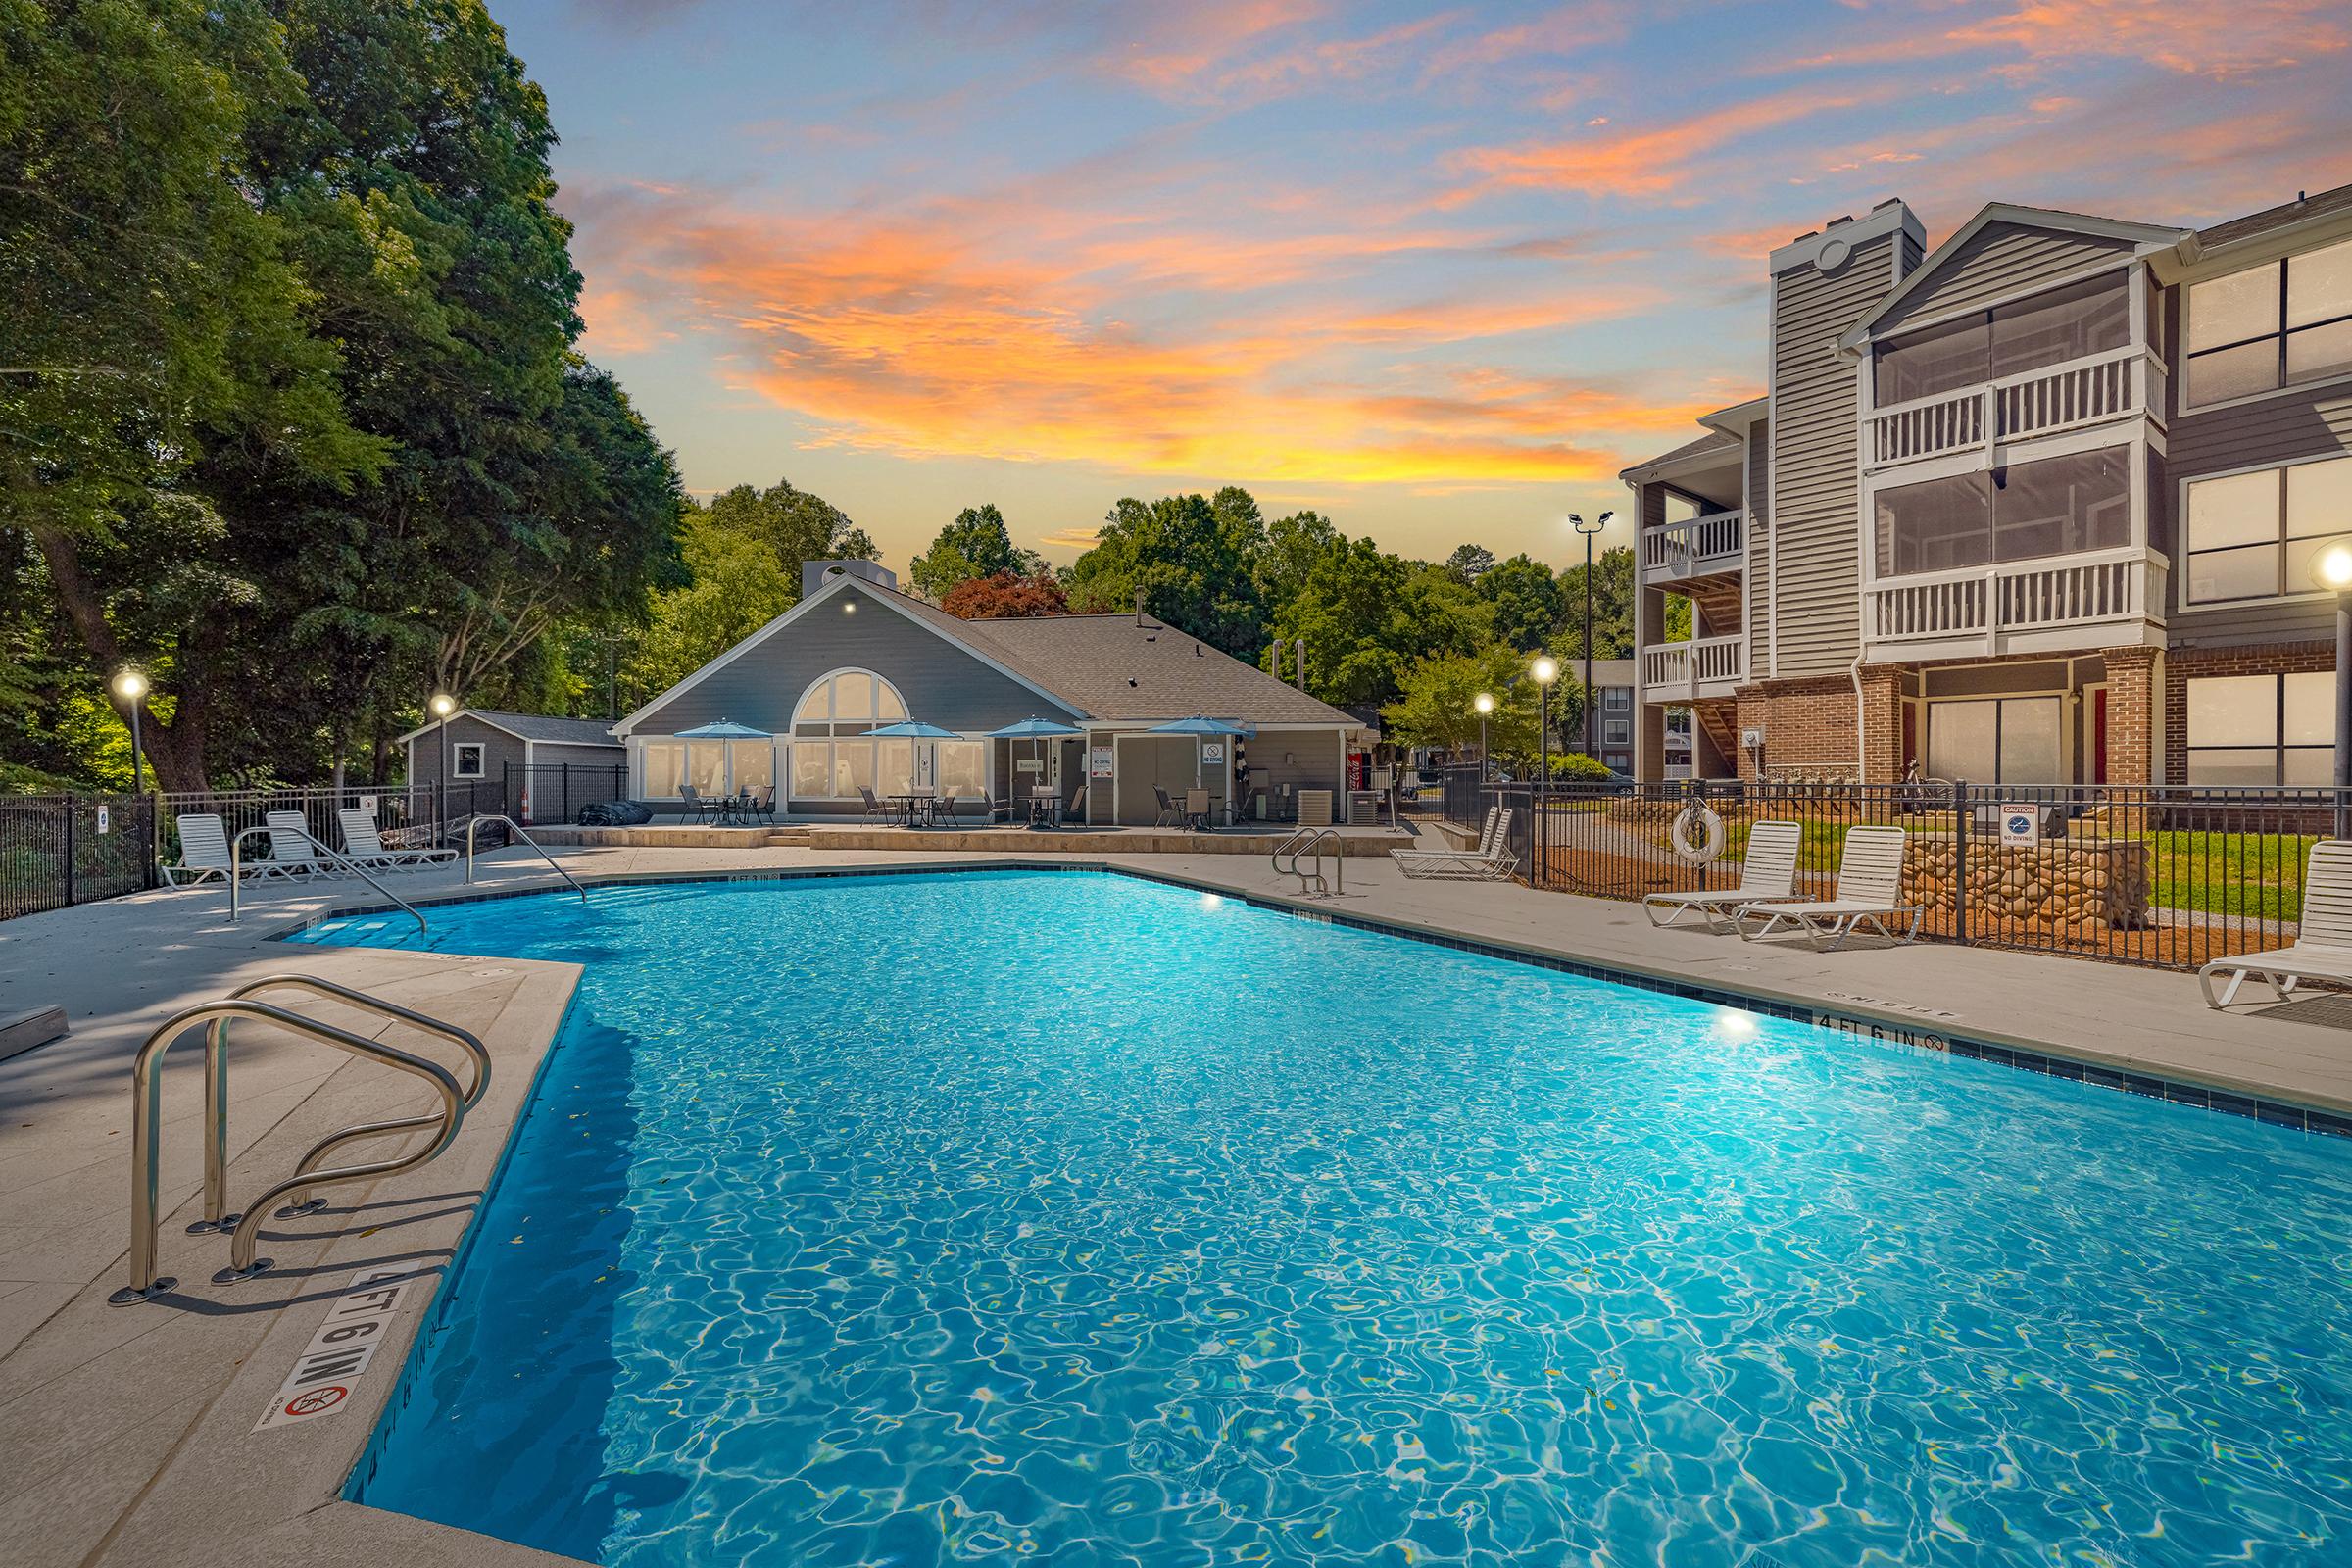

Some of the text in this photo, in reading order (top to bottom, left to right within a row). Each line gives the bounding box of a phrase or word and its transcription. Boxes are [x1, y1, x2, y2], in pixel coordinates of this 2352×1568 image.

[1819, 1014, 1915, 1047] 4 FT 6 IN
[339, 1287, 400, 1315] FT
[321, 1321, 380, 1344] 6
[294, 1347, 368, 1386] IN
[275, 1396, 286, 1404] NO
